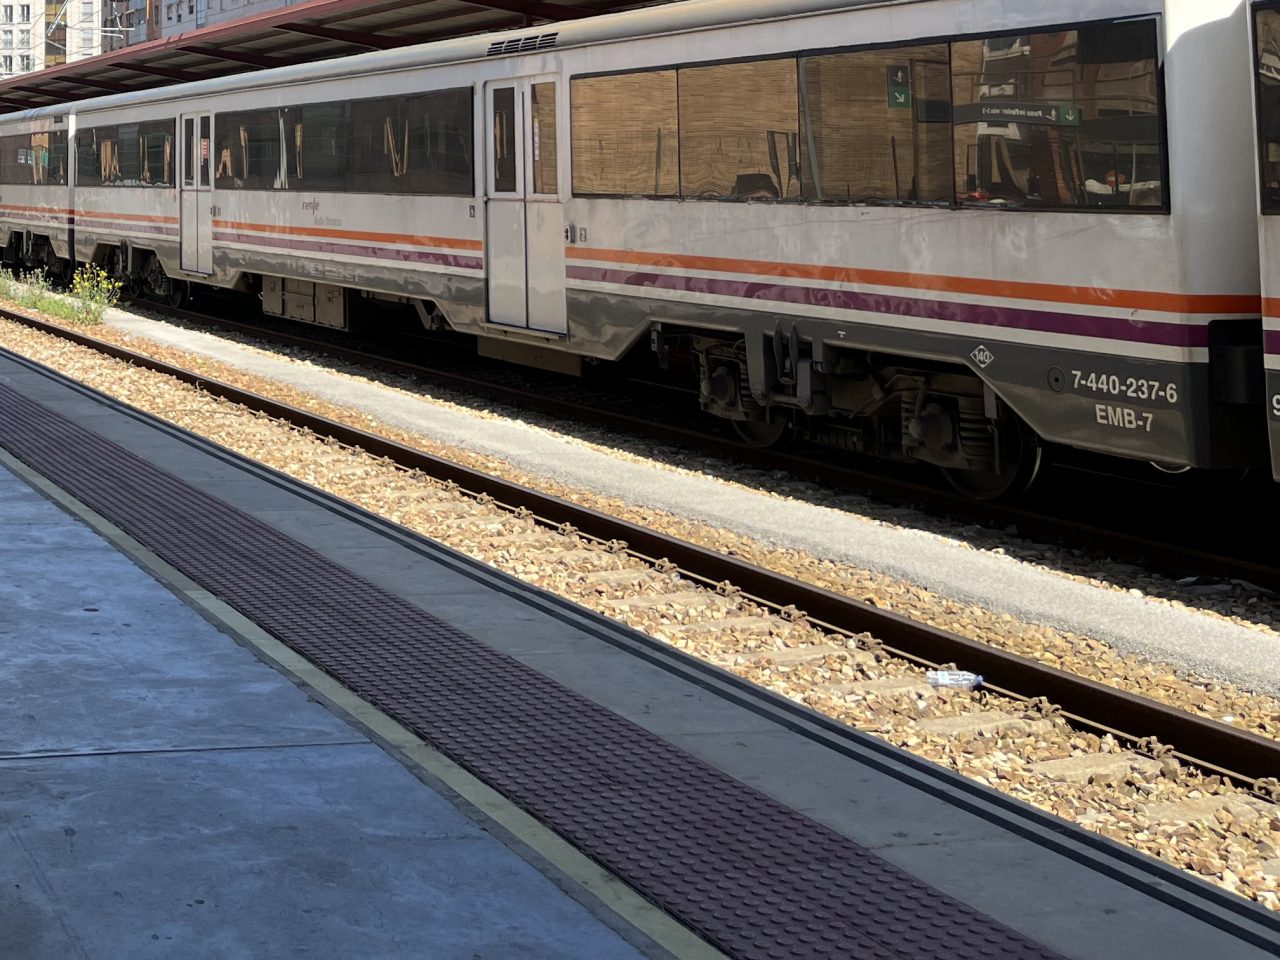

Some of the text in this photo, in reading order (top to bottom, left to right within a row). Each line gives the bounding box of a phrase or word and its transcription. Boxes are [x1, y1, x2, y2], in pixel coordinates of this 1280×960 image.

[302, 197, 320, 215] renfe
[975, 351, 990, 363] 140
[1071, 370, 1178, 404] 7-440-237-6
[1094, 404, 1154, 432] EMB-7
